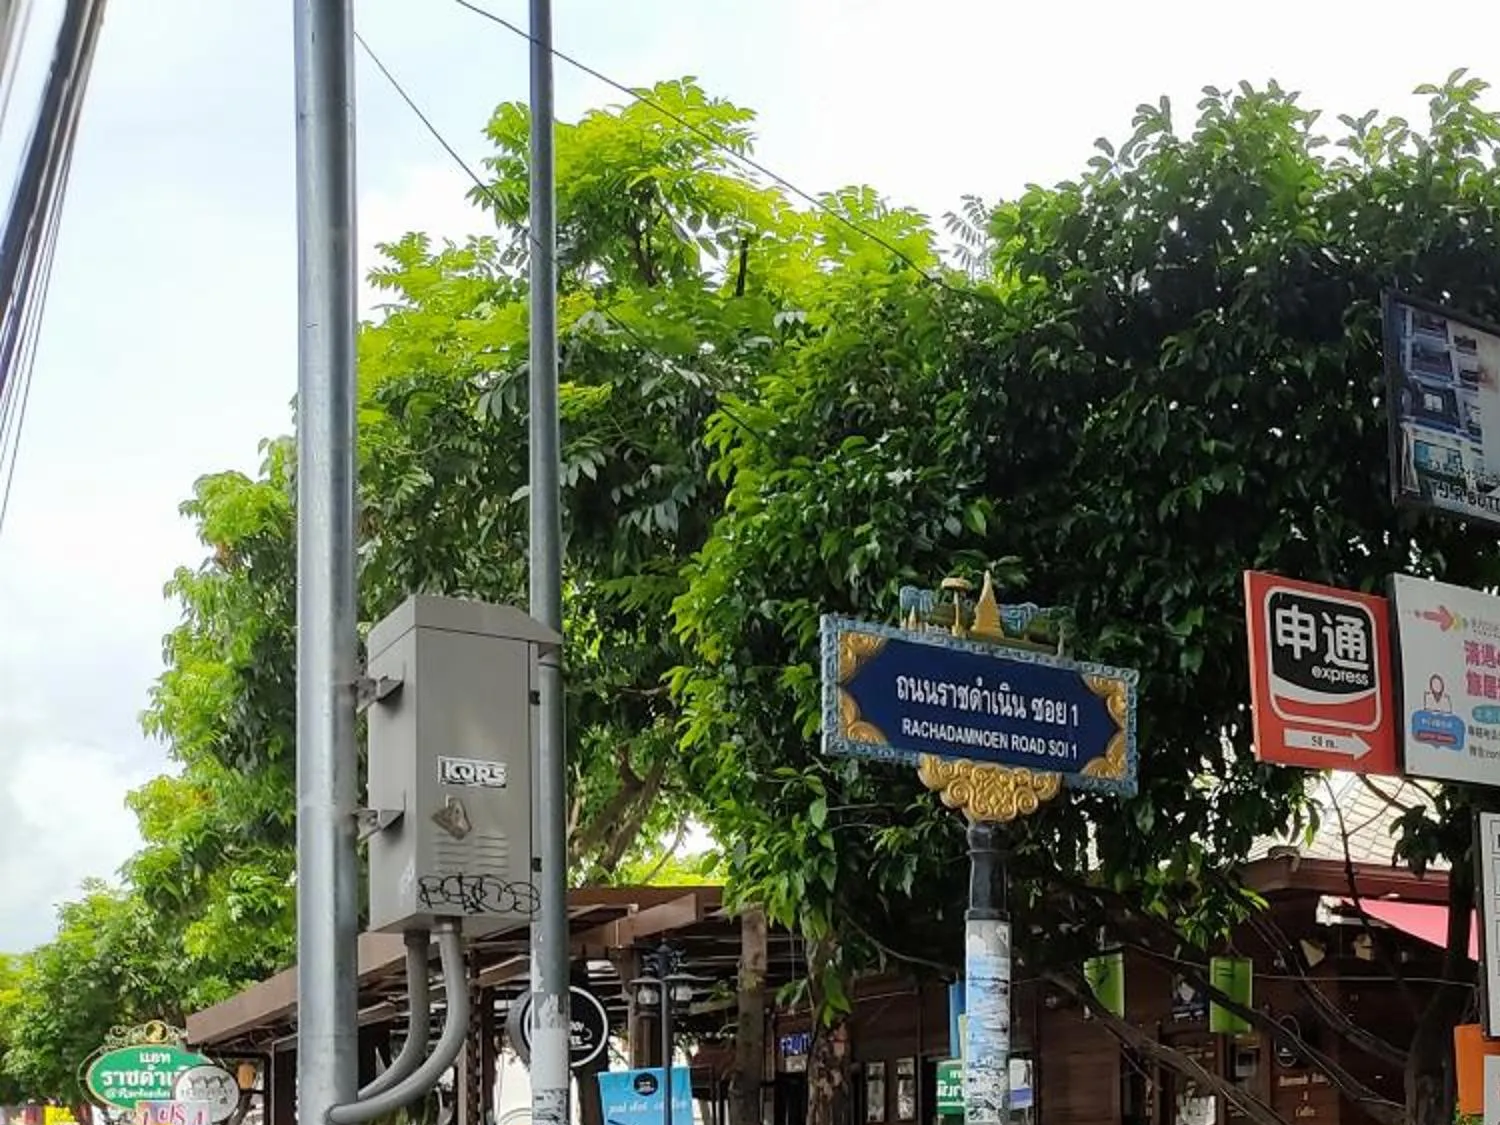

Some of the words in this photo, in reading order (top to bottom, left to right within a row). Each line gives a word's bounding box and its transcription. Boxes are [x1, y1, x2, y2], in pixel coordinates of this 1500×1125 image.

[1275, 604, 1369, 670] 申通
[1311, 664, 1369, 687] express
[896, 674, 1027, 720] ถนนราชดำเนิน
[1031, 699, 1067, 726] ซอย
[1071, 704, 1079, 726] 1
[902, 717, 1008, 749] RACHADAMNOEN
[1010, 735, 1045, 756] ROAD
[1048, 740, 1069, 758] SOI
[1070, 744, 1078, 759] 1
